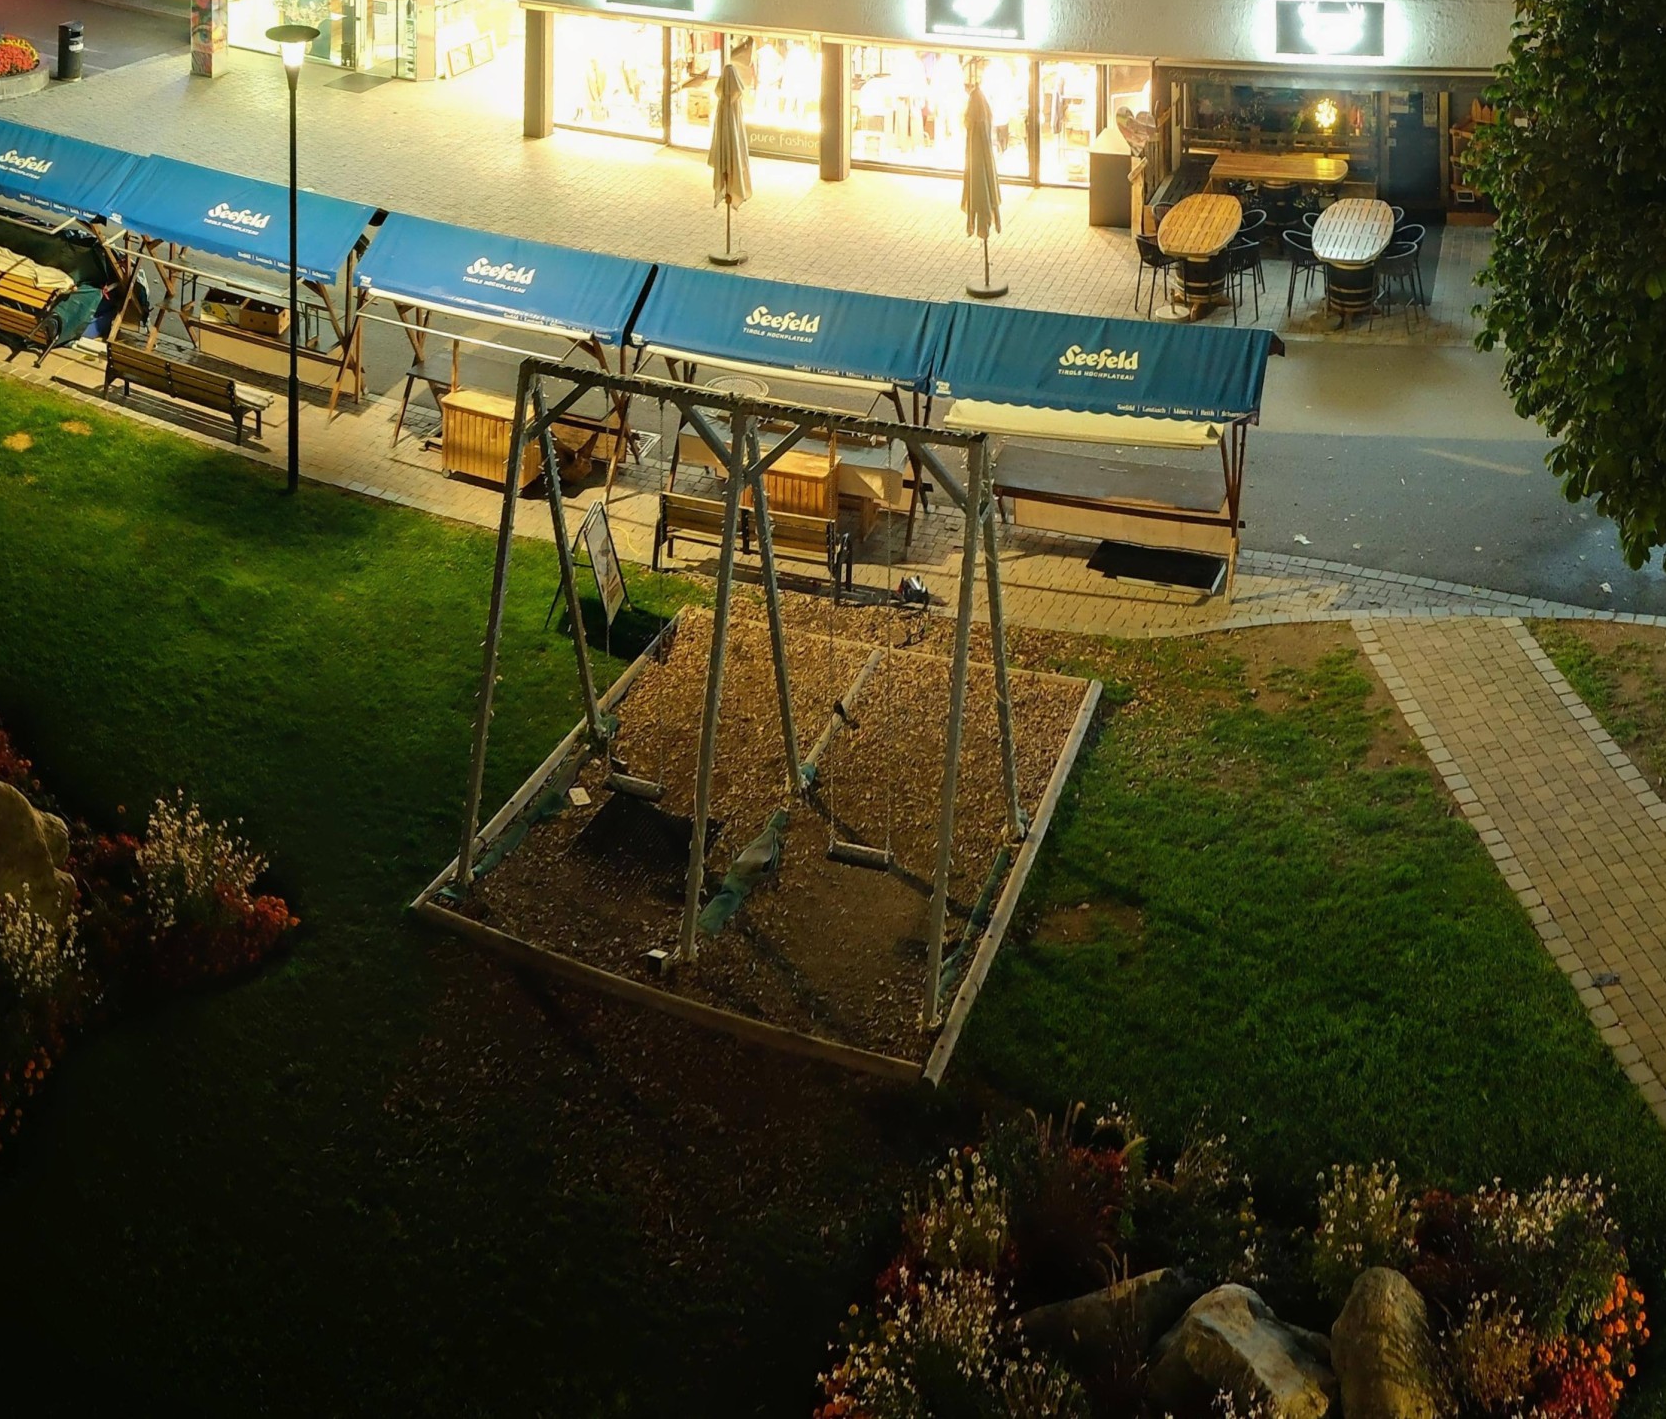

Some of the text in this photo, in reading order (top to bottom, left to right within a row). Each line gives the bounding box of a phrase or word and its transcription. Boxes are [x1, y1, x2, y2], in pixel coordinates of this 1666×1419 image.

[749, 132, 776, 144] pure
[208, 202, 272, 230] Seefeld
[466, 256, 536, 286] Seefeld
[462, 276, 526, 294] TIROLS HOCHPLATEAU
[745, 305, 822, 334] Seefeld
[742, 327, 814, 343] TIROLS HOCHPLATEAU
[1058, 344, 1139, 371] Seefeld
[1057, 368, 1135, 381] TIROLS HOCHPLATEAU
